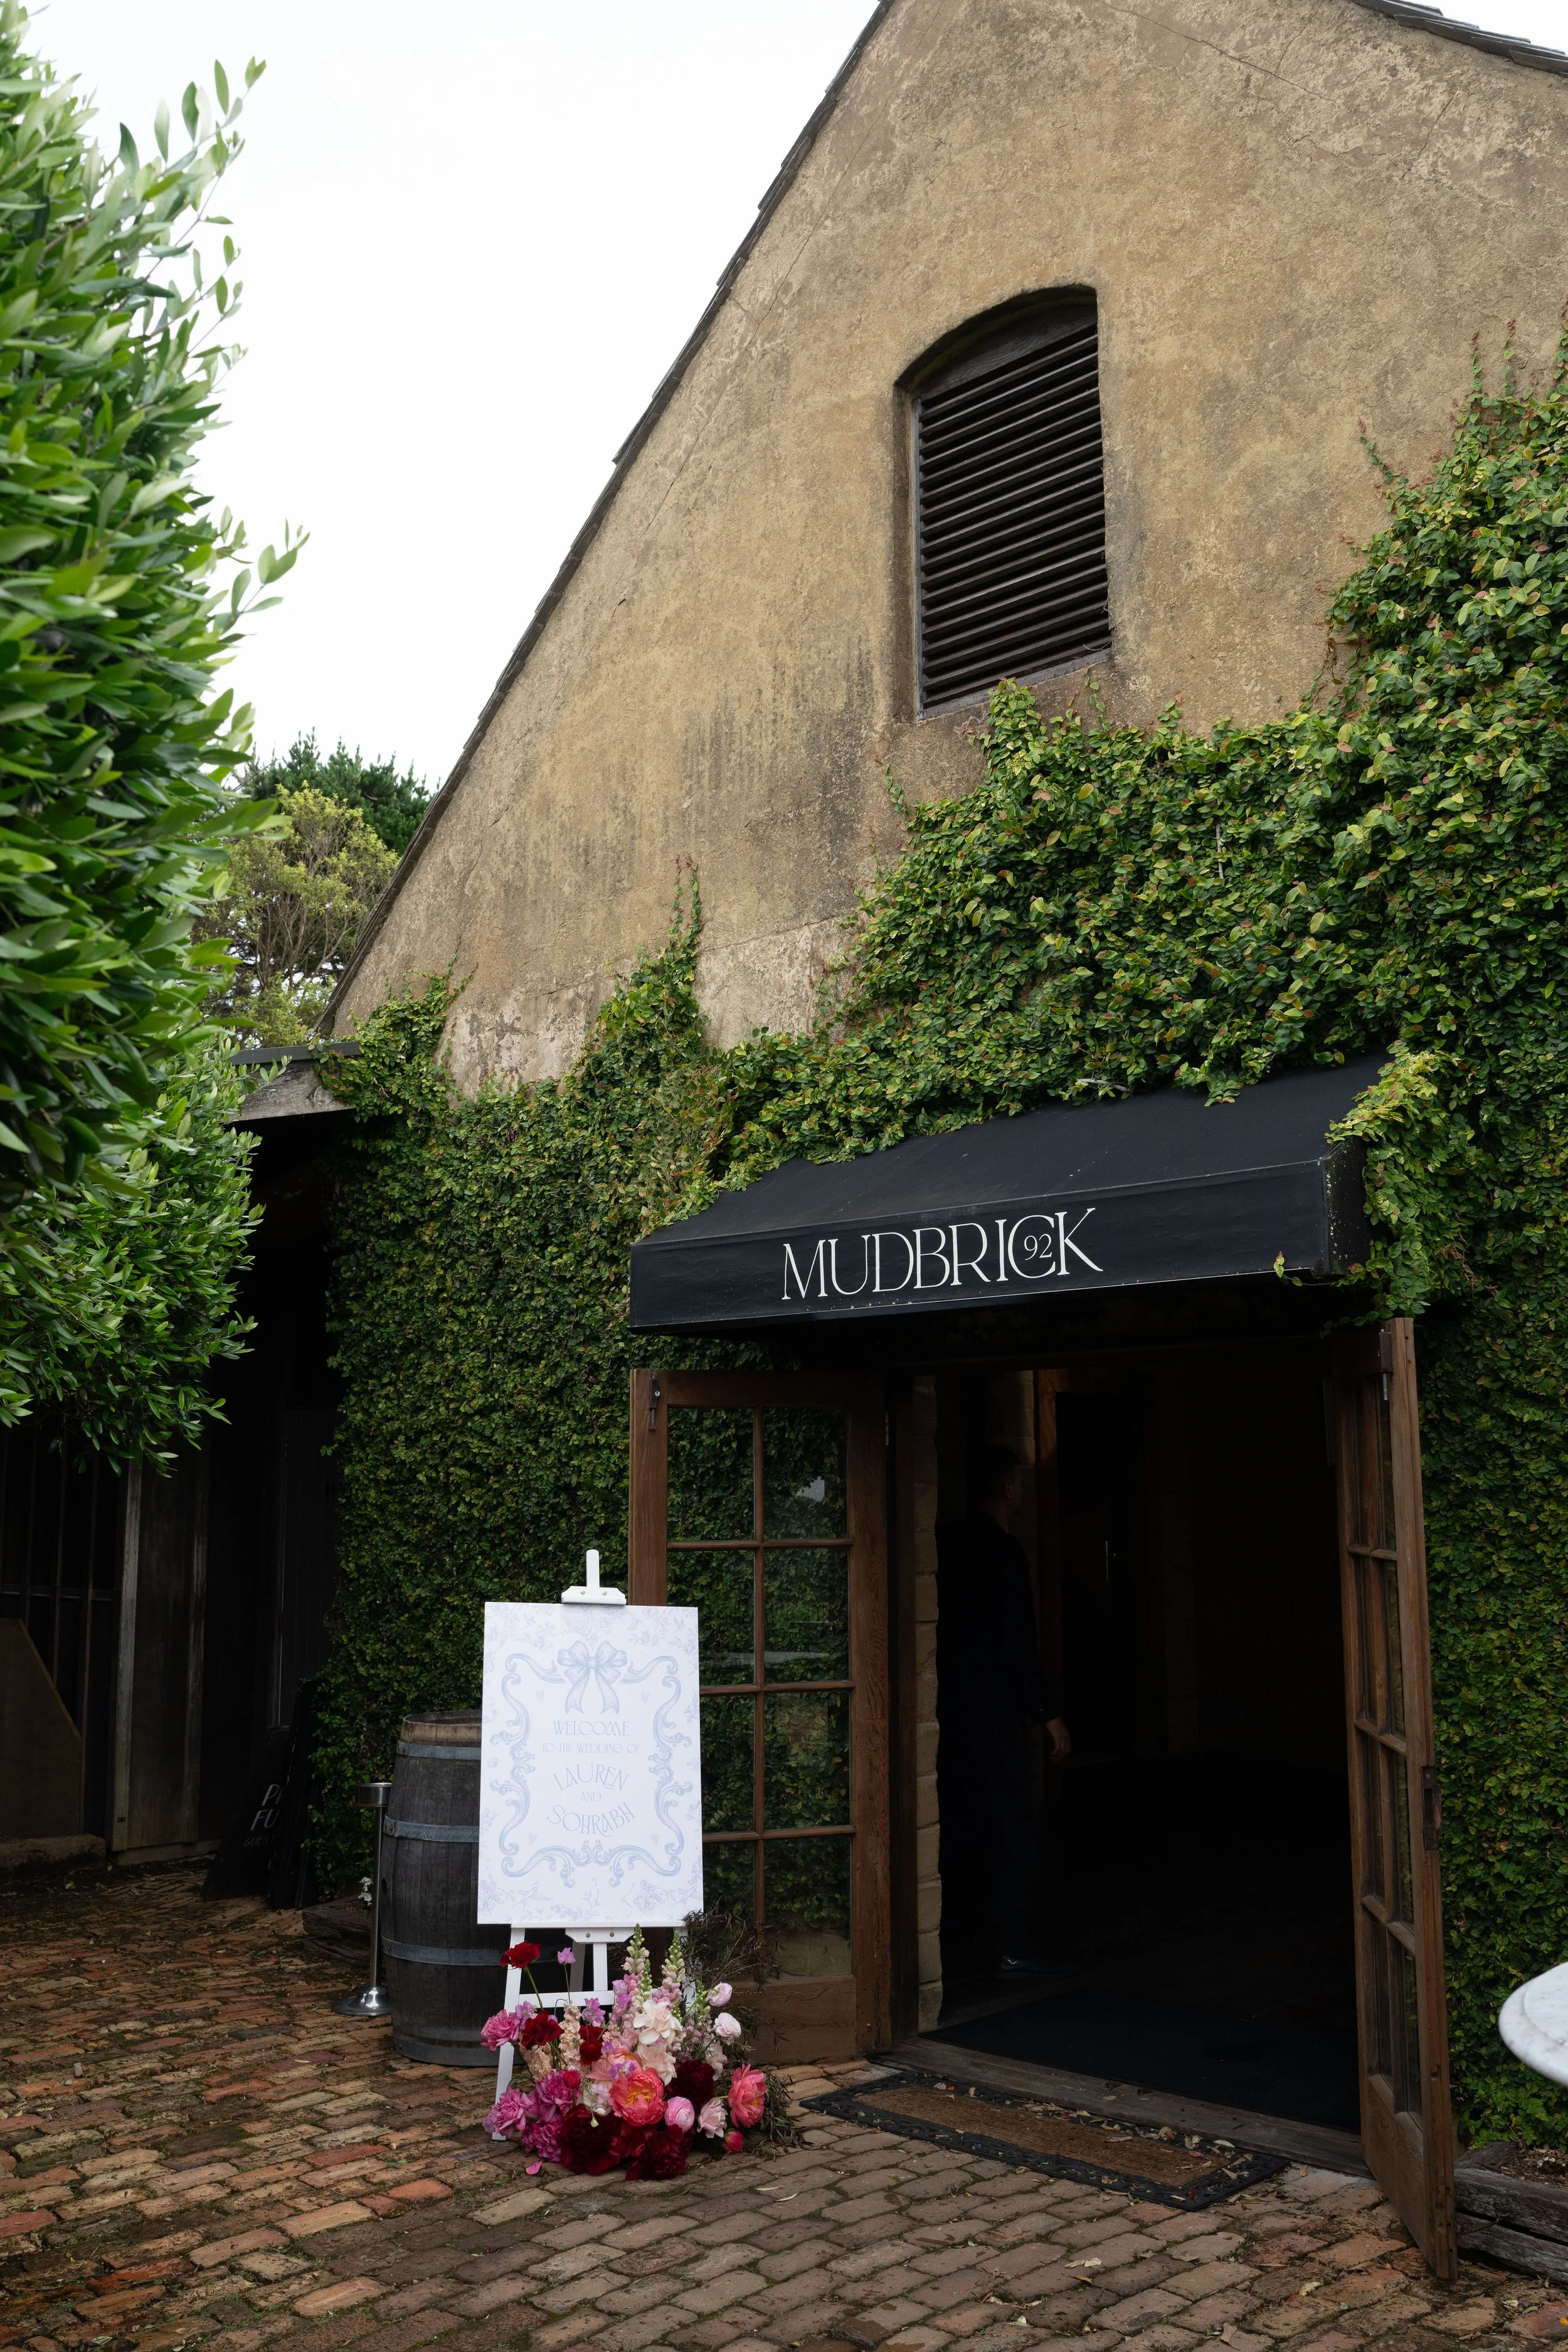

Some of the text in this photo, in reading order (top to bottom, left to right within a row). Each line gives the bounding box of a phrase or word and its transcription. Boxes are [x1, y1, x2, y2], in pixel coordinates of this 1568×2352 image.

[781, 1208, 1103, 1300] MUDBRICK
[1024, 1233, 1052, 1261] 92
[553, 1720, 630, 1736] WELCOME
[542, 1743, 640, 1754] TO THE WEDDING OF
[553, 1763, 629, 1791] LAUREN
[581, 1791, 601, 1801] AND
[546, 1802, 635, 1838] SOHRABH
